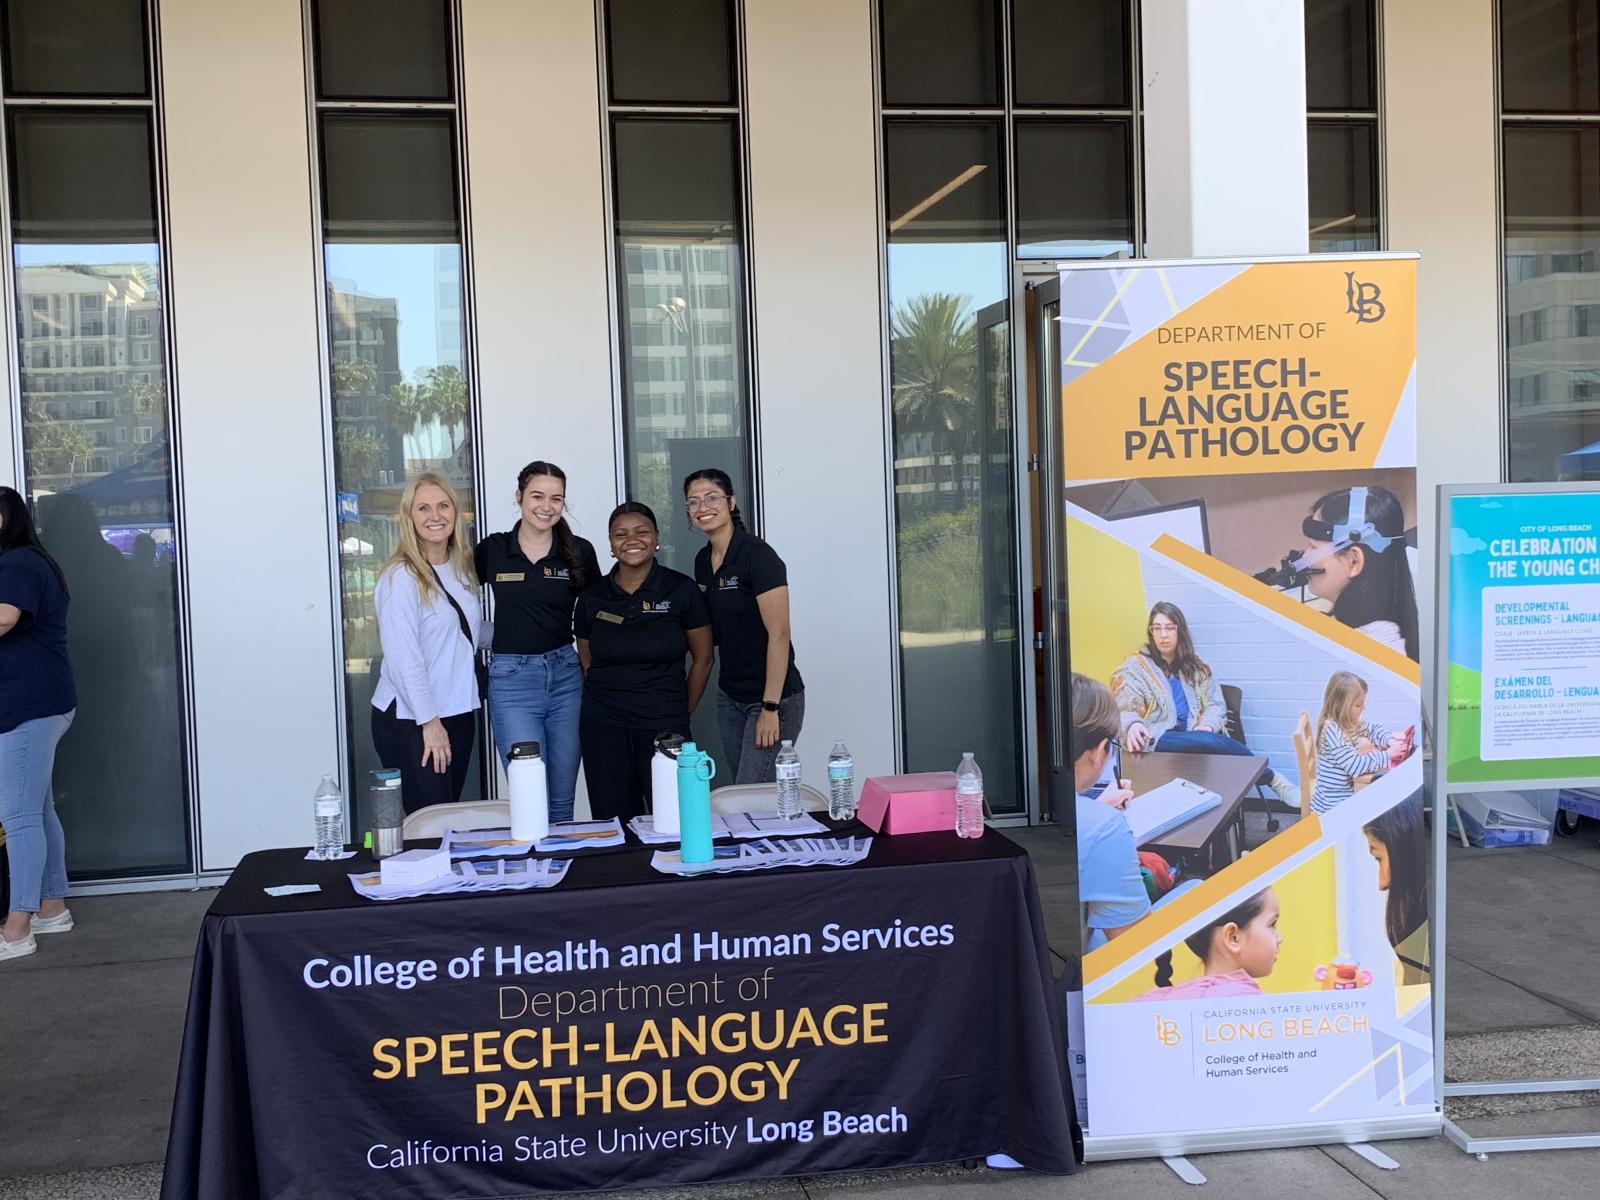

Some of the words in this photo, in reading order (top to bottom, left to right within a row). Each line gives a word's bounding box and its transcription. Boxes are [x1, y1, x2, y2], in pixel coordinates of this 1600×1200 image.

[1158, 323, 1294, 344] DEPARTMENT
[1299, 322, 1327, 339] OF
[1164, 358, 1321, 392] SPEECH-
[1139, 389, 1350, 427] LANGUAGE
[1124, 422, 1366, 461] PATHOLOGY
[1520, 525, 1536, 533] CITY
[1568, 524, 1592, 532] BEACH
[1490, 537, 1597, 557] CELEBRATION
[1488, 560, 1517, 578] THE
[1522, 559, 1575, 578] YOUNG
[1495, 601, 1570, 613] DEVELOPMENTAL
[1495, 614, 1552, 626] SCREENINGS
[1536, 676, 1552, 686] DEL
[1494, 688, 1554, 700] DESARROLLO
[303, 954, 438, 990] College
[448, 947, 485, 979] of
[495, 939, 609, 976] Health
[620, 933, 681, 967] and
[693, 931, 811, 962] Human
[822, 918, 955, 952] Services
[500, 972, 725, 1023] Department
[738, 966, 774, 1001] of
[1203, 1008, 1267, 1019] CALIFORNIA
[1270, 1005, 1301, 1015] STATE
[1305, 1001, 1367, 1012] UNIVERSITY
[1203, 1020, 1275, 1044] LONG
[1283, 1015, 1369, 1038] BEACH
[372, 1002, 888, 1080] SPEECH-LANGUAGE
[1205, 1054, 1245, 1066] College
[1248, 1052, 1259, 1062] of
[1261, 1050, 1295, 1061] Health
[1297, 1048, 1317, 1059] and
[1206, 1068, 1243, 1078] Human
[1246, 1065, 1289, 1076] Services
[476, 1059, 800, 1124] PATHOLOGY
[367, 1138, 503, 1169] California
[514, 1134, 586, 1161] State
[598, 1120, 737, 1154] University
[746, 1117, 814, 1143] Long
[823, 1106, 908, 1136] Beach
